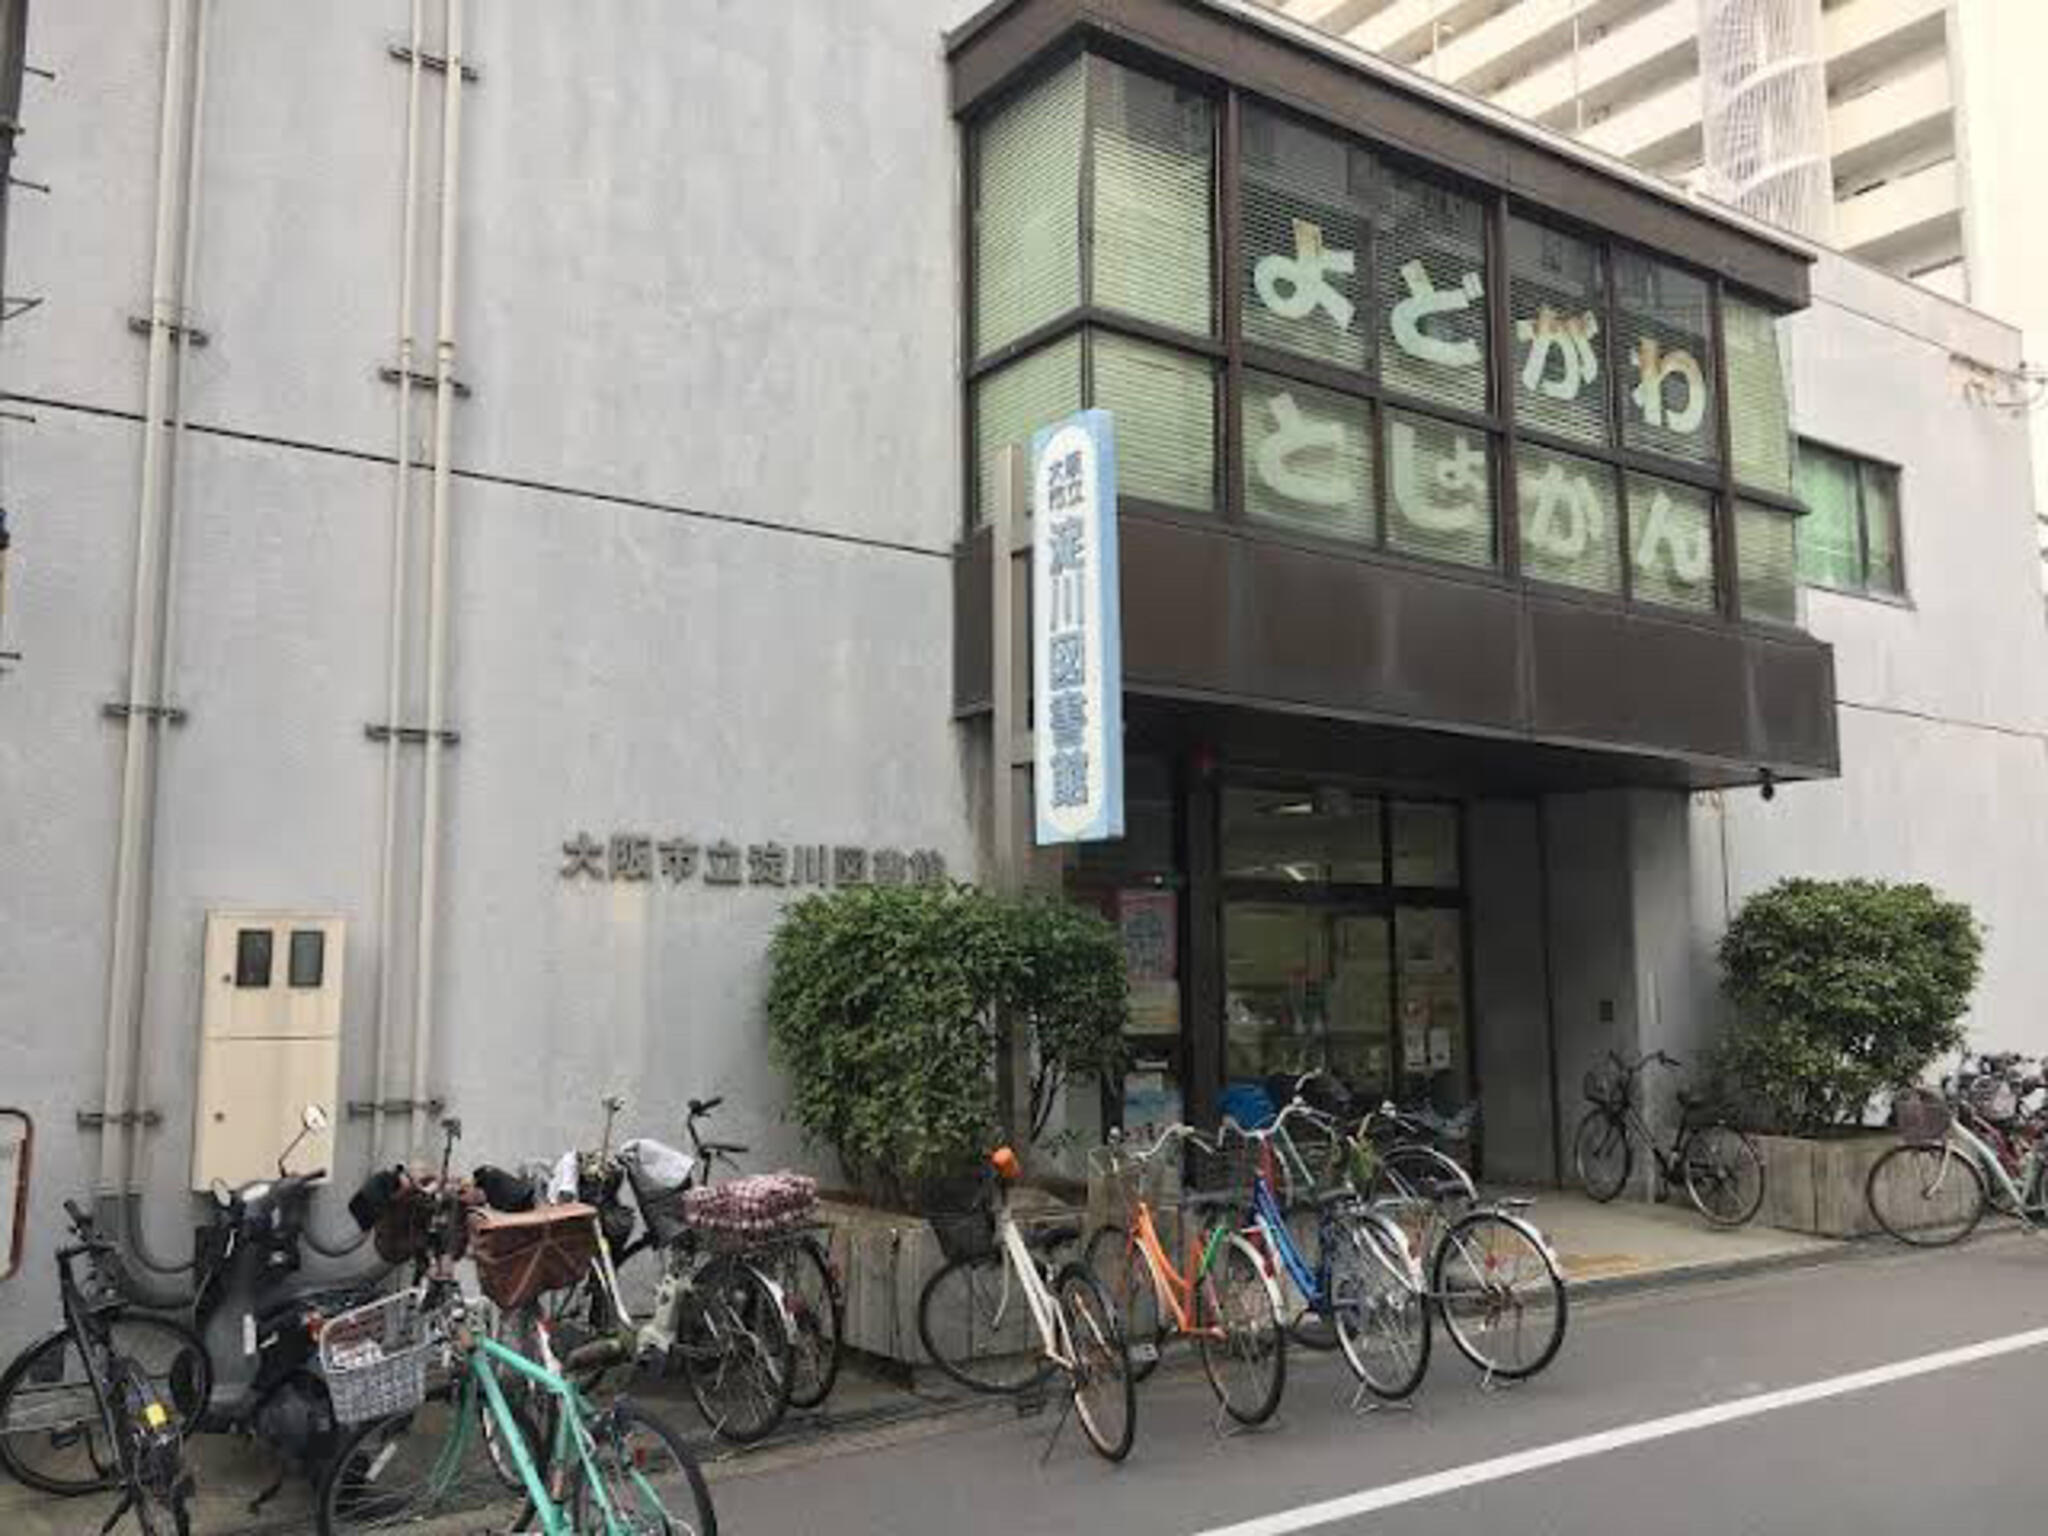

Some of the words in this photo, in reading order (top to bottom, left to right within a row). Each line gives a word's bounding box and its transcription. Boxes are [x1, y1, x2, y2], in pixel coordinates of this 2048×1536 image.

[1254, 217, 1706, 434] よどがわ
[1257, 392, 1712, 581] としょかん
